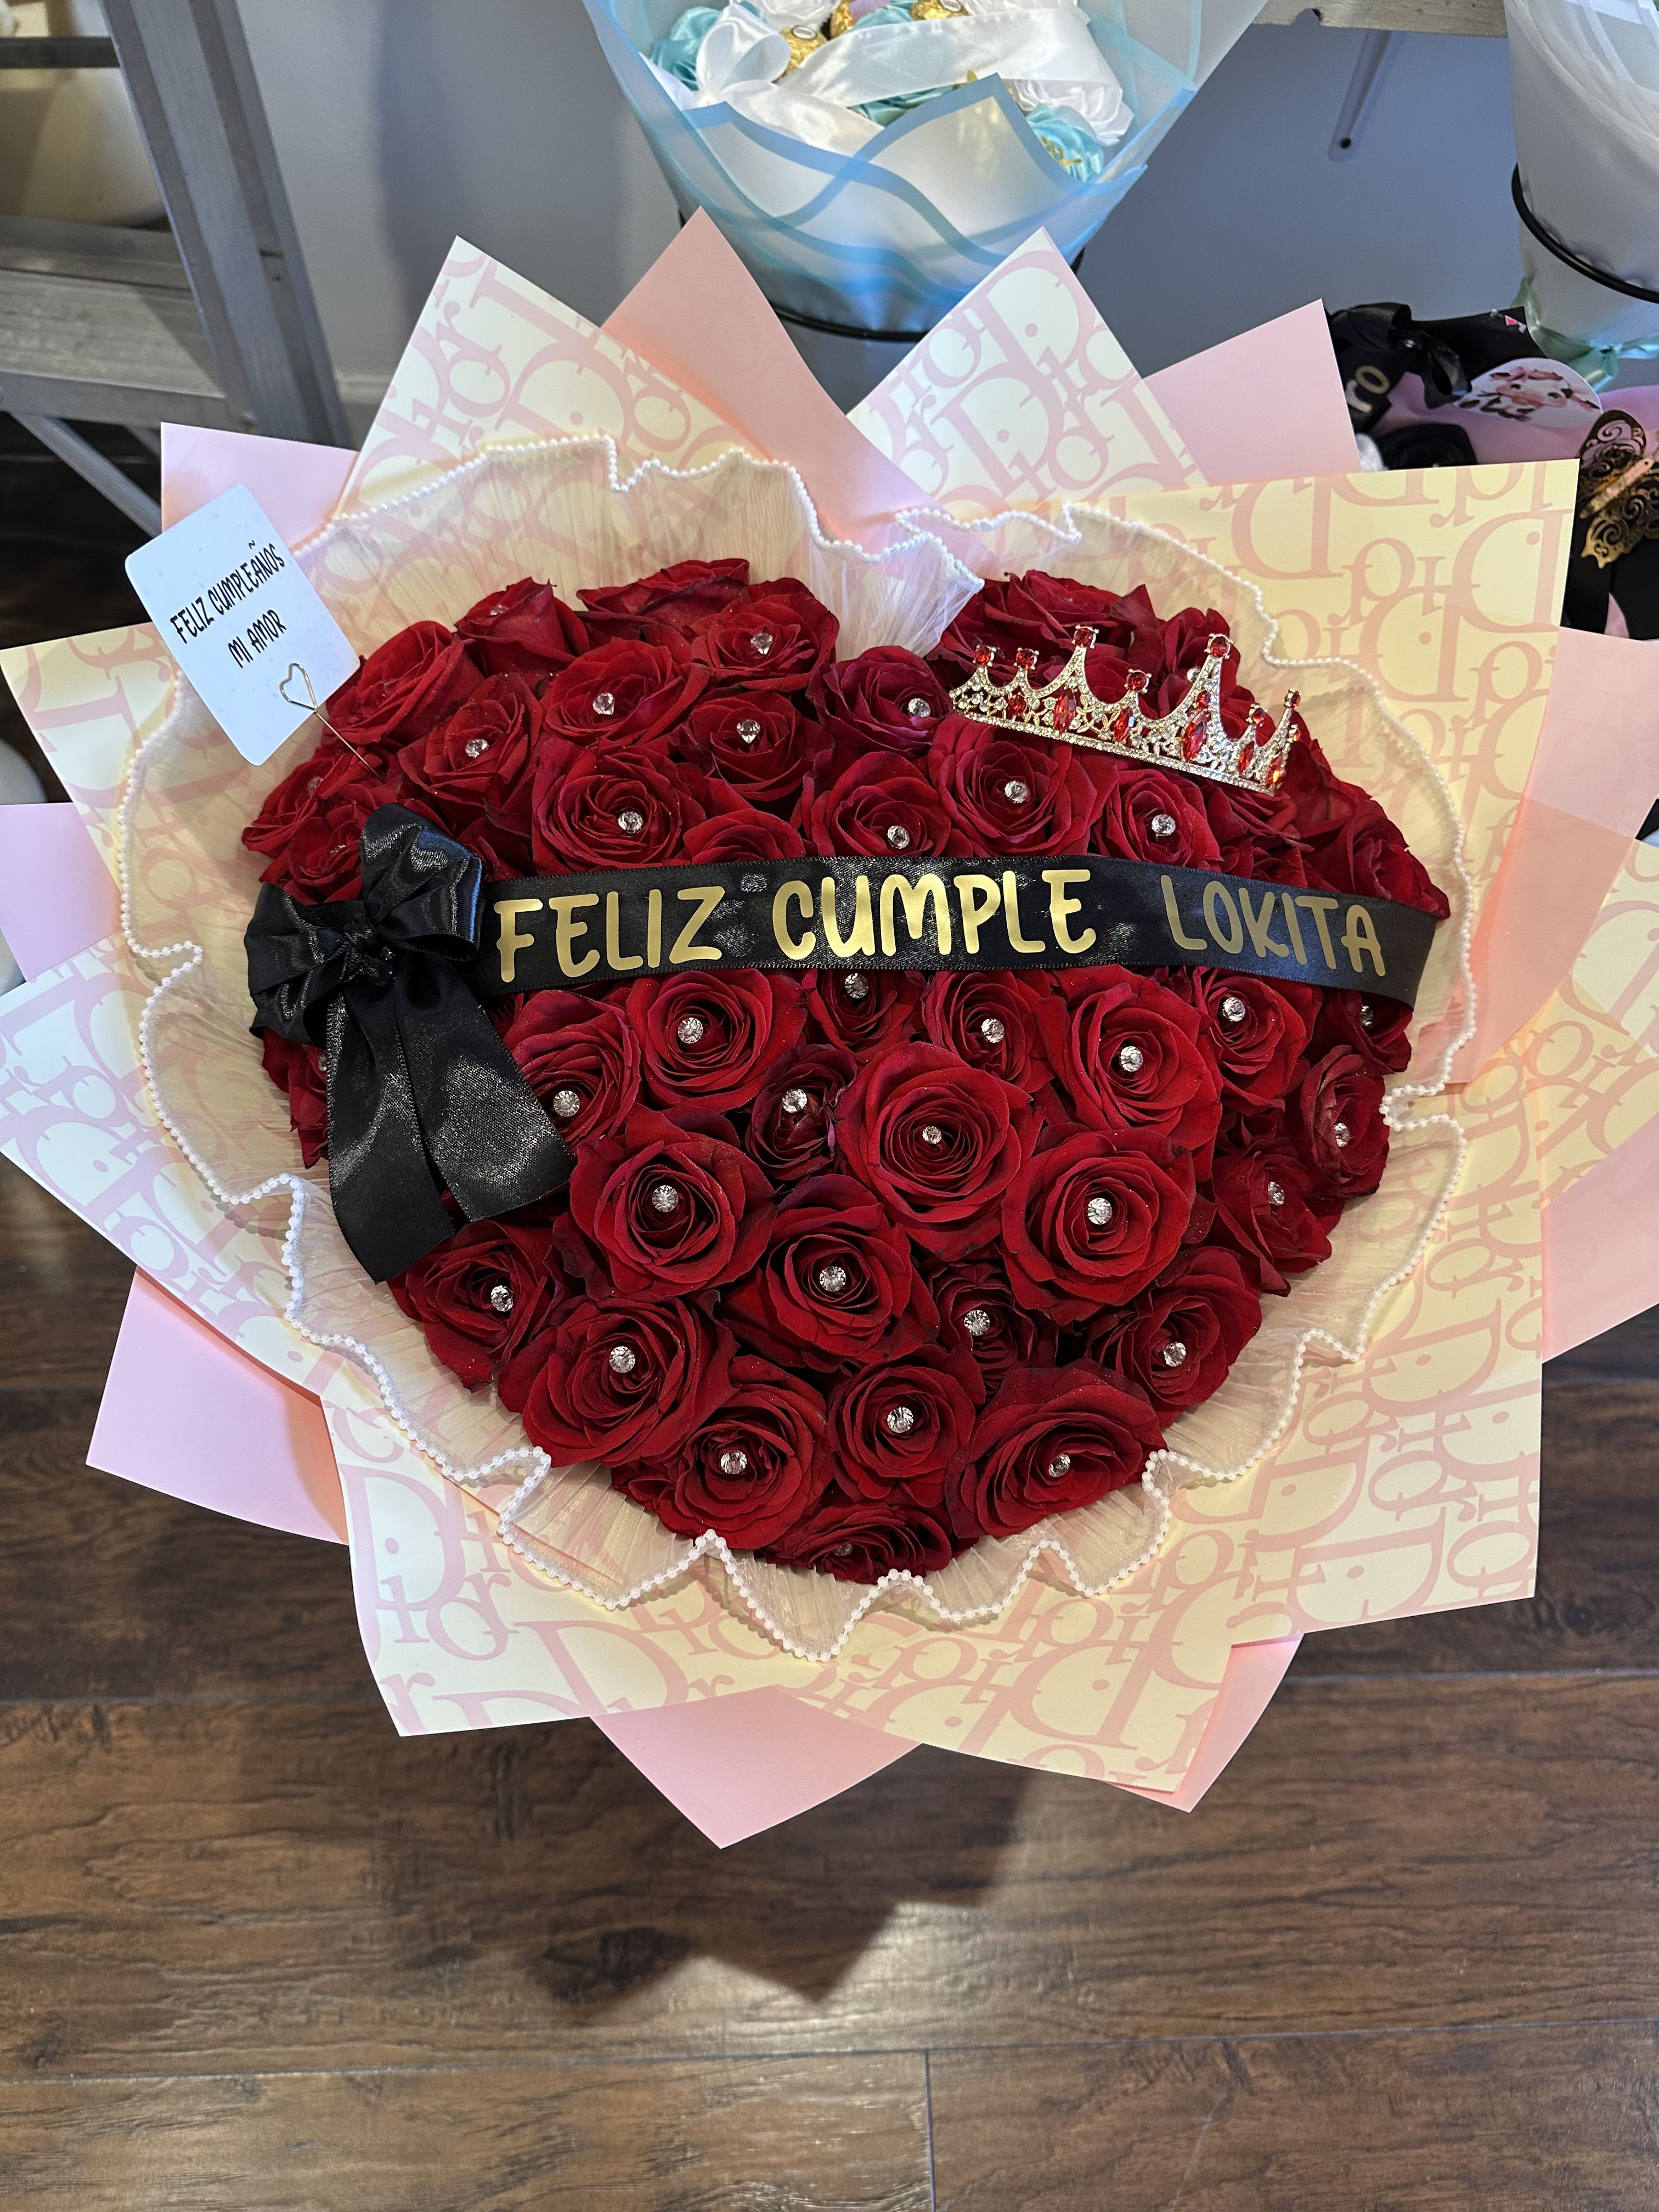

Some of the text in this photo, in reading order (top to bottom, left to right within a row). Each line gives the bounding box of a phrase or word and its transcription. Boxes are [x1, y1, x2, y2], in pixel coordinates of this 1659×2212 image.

[170, 540, 285, 644] FELIZ CUMPLEAÑOS
[228, 609, 287, 668] MI AMOR
[494, 869, 1386, 983] FELIZ CUMPLE LOKITA
